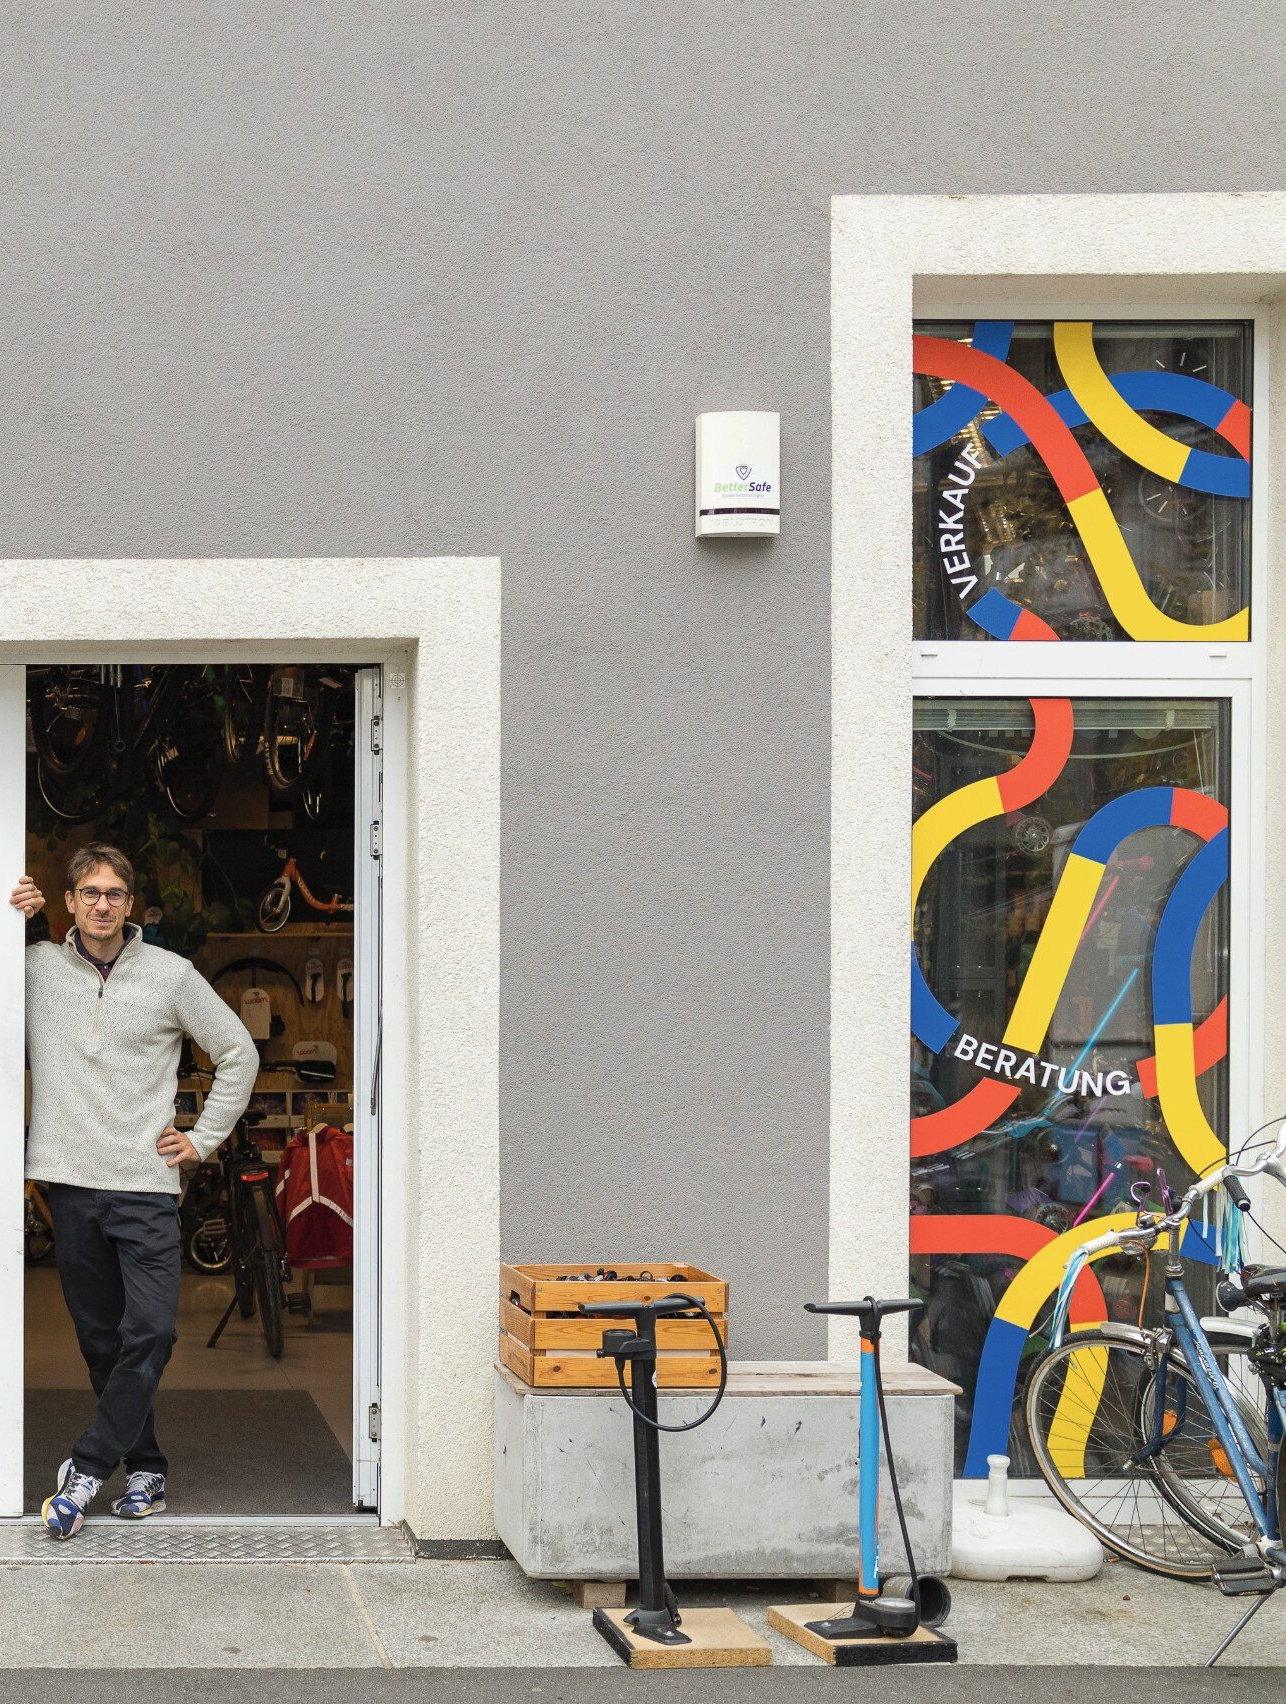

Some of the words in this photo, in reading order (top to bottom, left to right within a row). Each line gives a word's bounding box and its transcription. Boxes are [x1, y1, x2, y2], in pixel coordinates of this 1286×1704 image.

[714, 482, 772, 493] BetterSafe
[938, 442, 982, 600] VERKAUF
[954, 1033, 1132, 1098] BERATUNG
